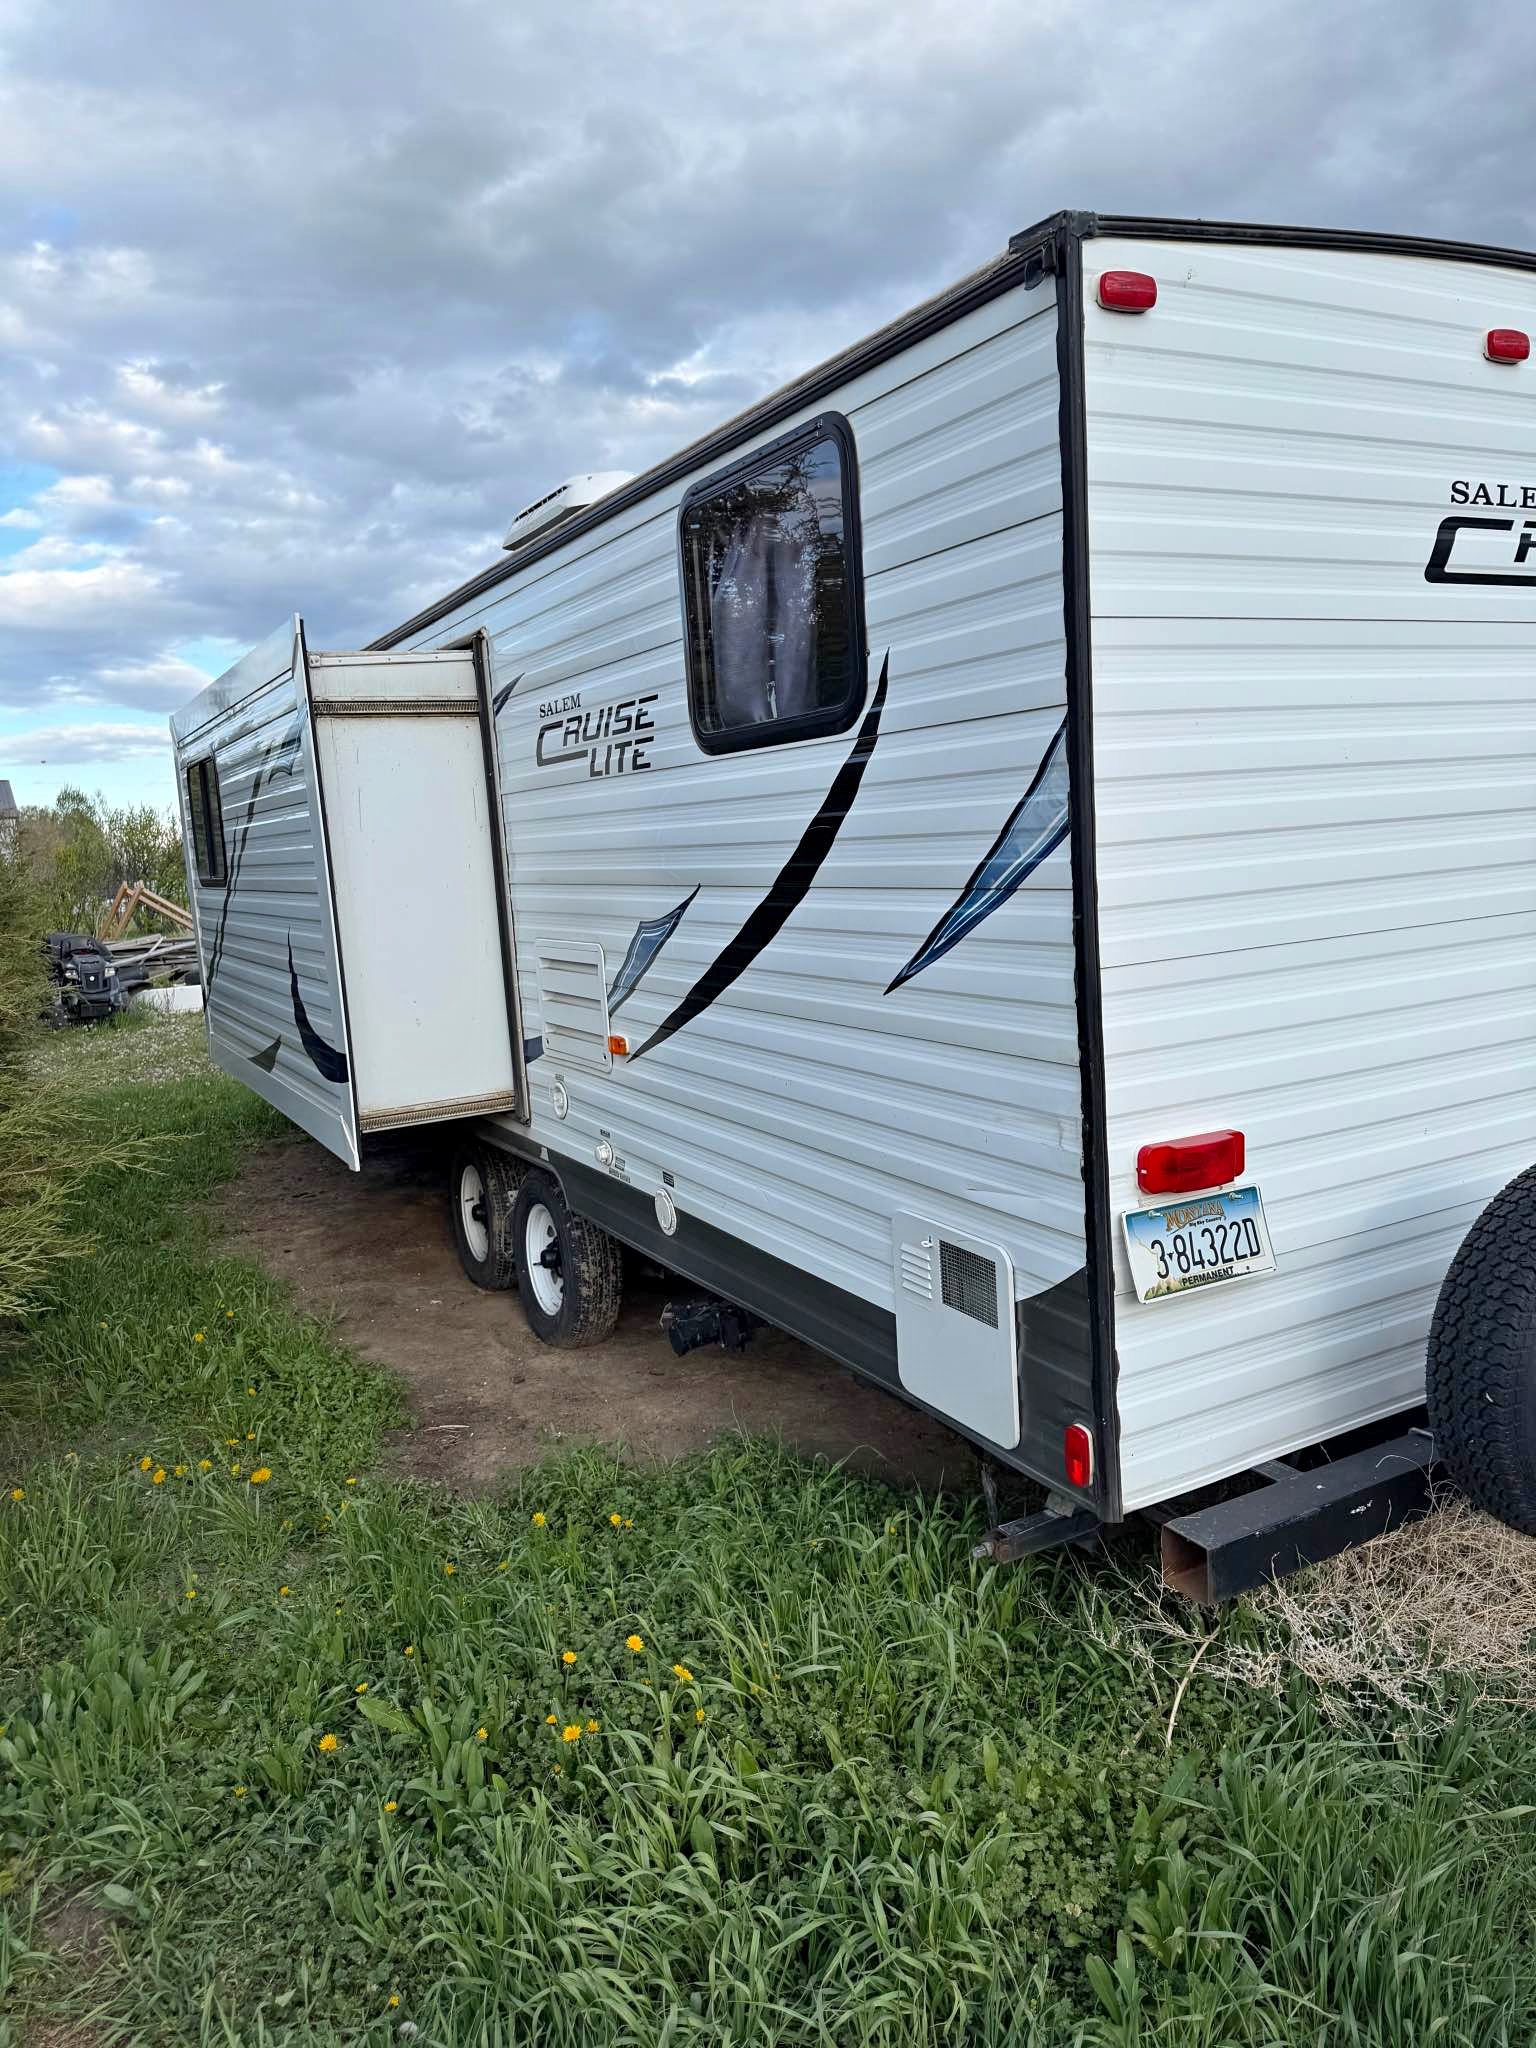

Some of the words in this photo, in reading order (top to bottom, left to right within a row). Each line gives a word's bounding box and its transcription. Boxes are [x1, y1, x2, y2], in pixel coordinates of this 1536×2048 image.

[1450, 480, 1536, 509] SALE
[539, 693, 582, 718] SALEM
[536, 694, 659, 767] CRUISE
[590, 736, 655, 777] LITE
[1163, 1200, 1225, 1231] MONTANA
[1182, 1265, 1234, 1287] PERMANENT
